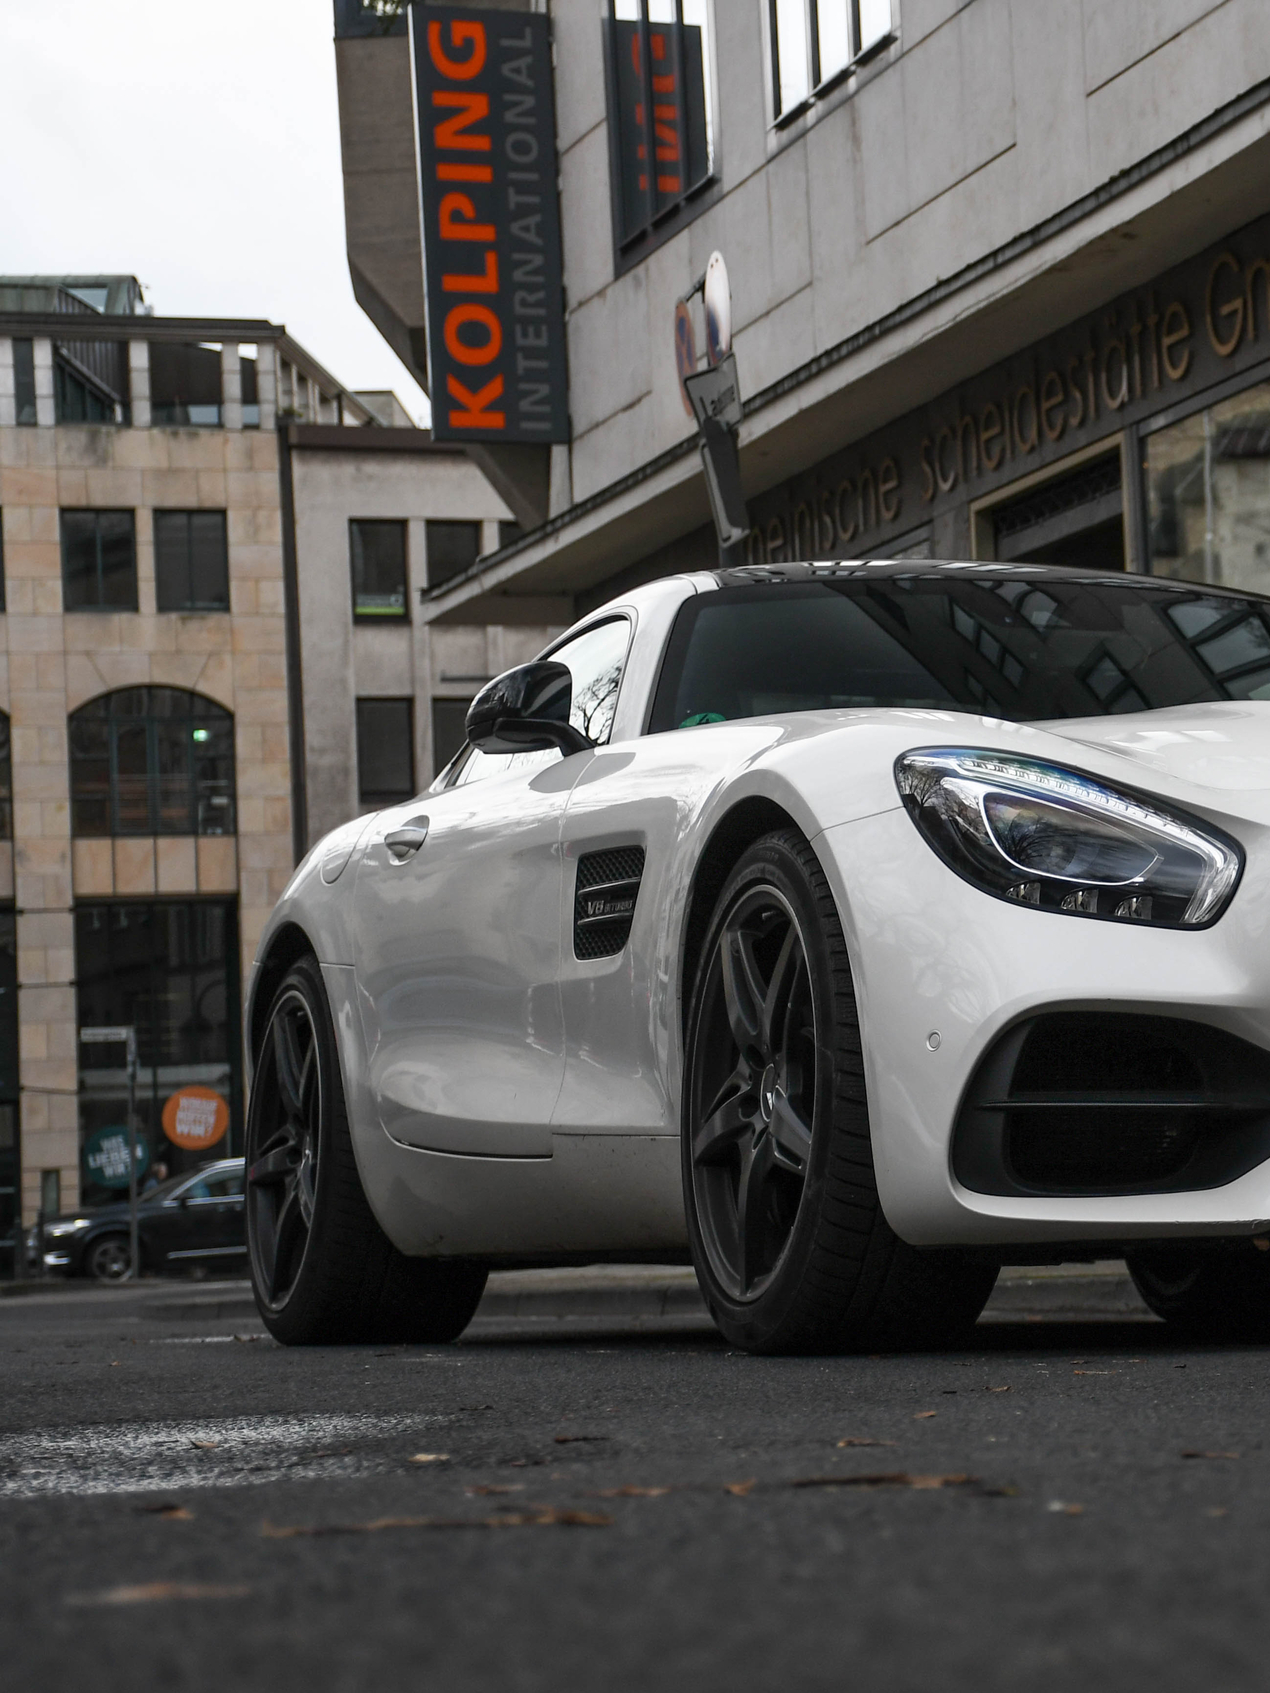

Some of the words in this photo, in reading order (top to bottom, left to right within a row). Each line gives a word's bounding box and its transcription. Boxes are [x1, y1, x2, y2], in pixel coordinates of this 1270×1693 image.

[427, 19, 506, 430] KOLPING
[500, 26, 552, 432] INTERNATIONAL
[921, 300, 1190, 501] scheidestätte
